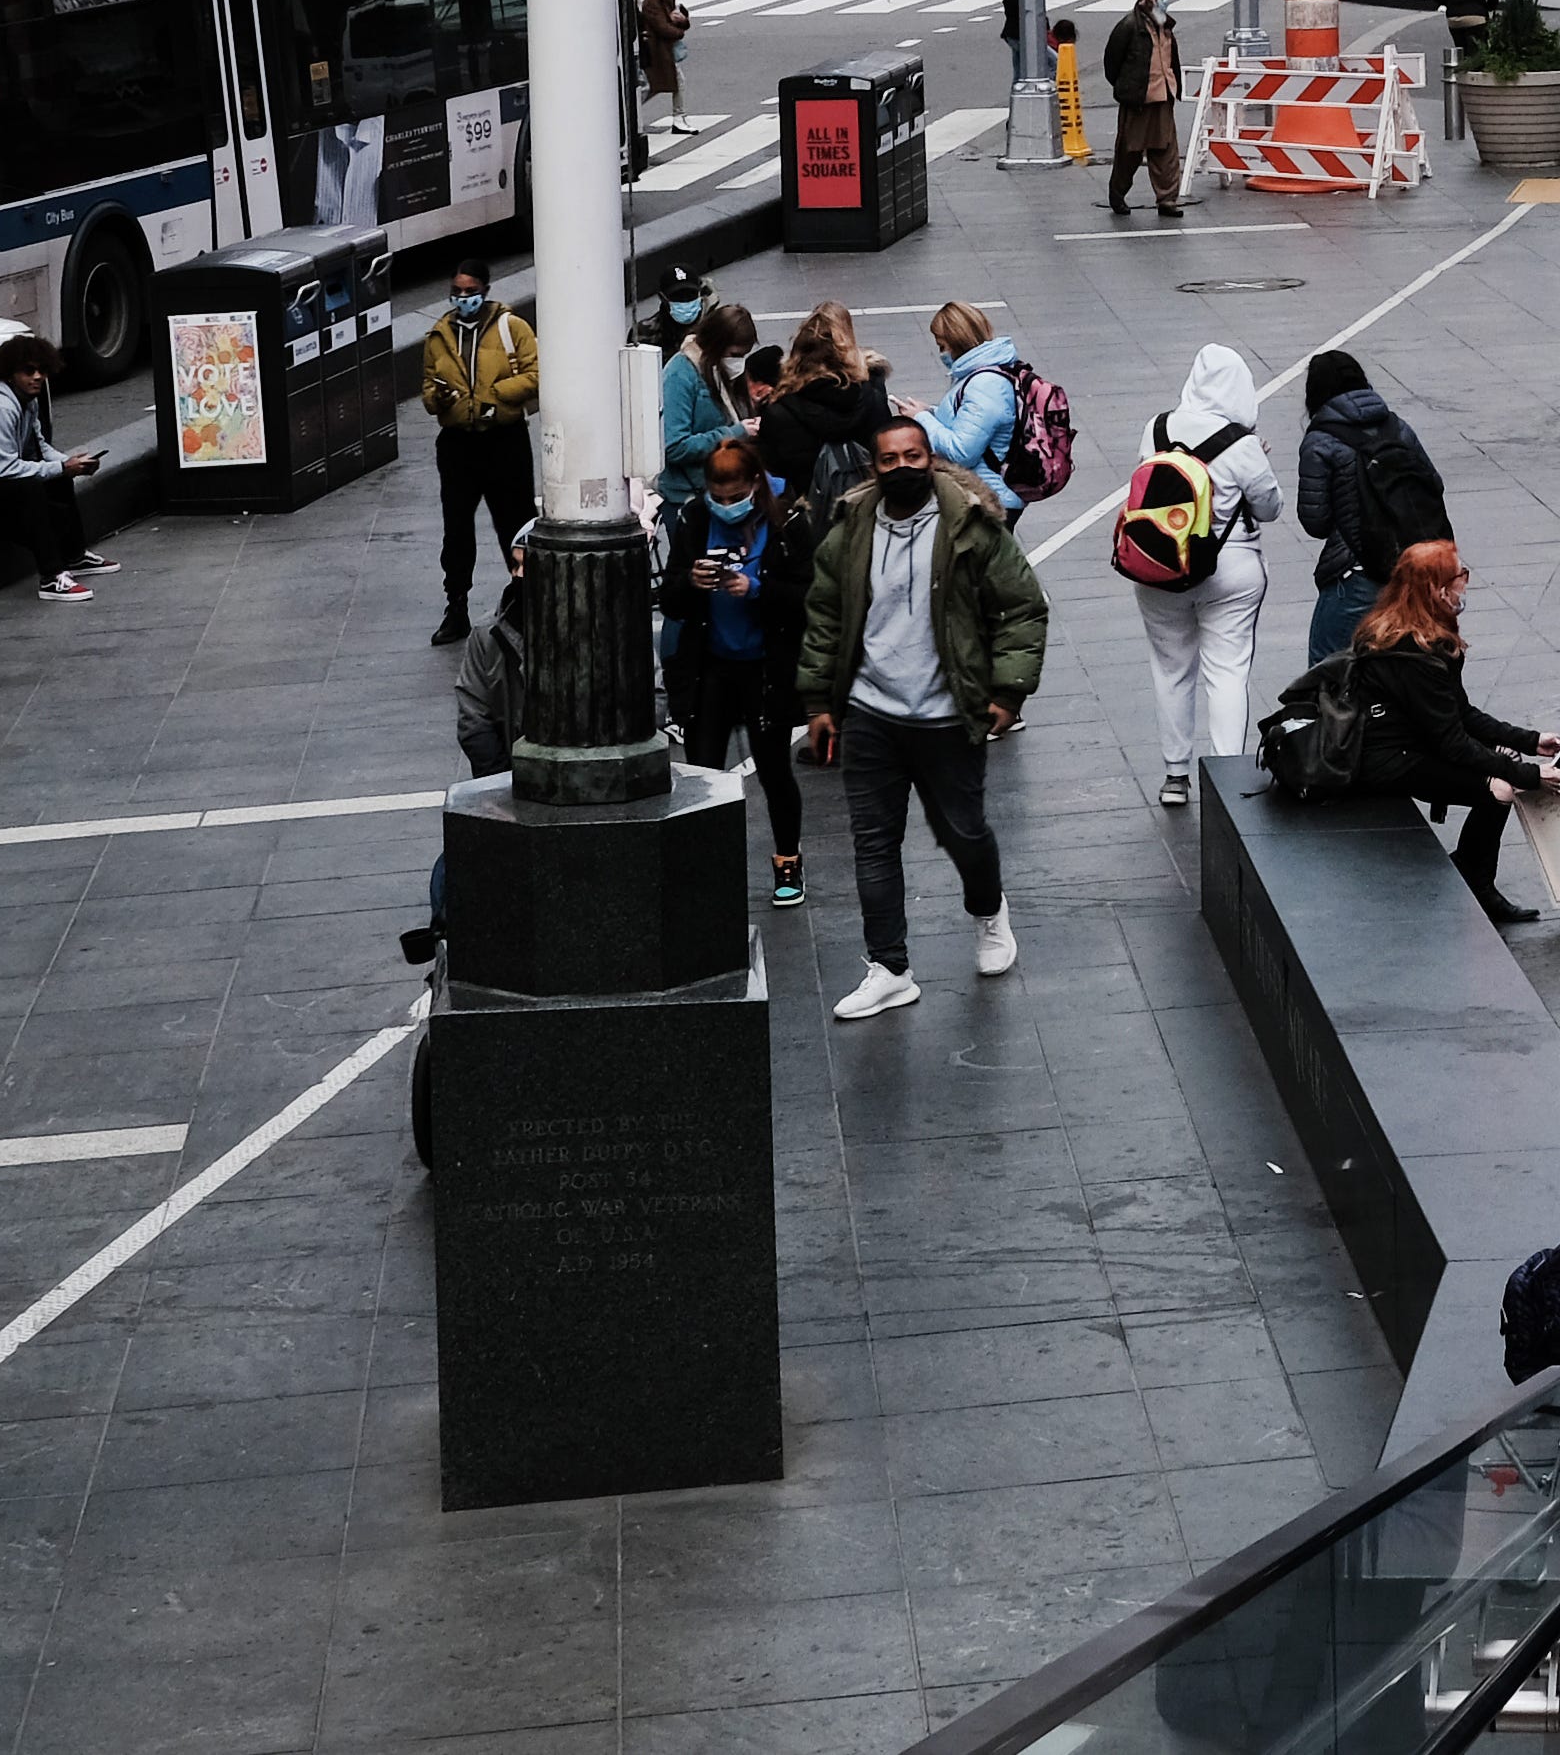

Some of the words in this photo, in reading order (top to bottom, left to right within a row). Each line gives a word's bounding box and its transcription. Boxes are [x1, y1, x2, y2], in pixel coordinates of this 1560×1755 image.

[807, 127, 831, 144] ALL
[835, 126, 849, 144] IN
[808, 145, 851, 162] TIMES
[801, 162, 857, 179] SQUARE
[178, 362, 253, 386] VOTE
[187, 395, 256, 419] LOVE
